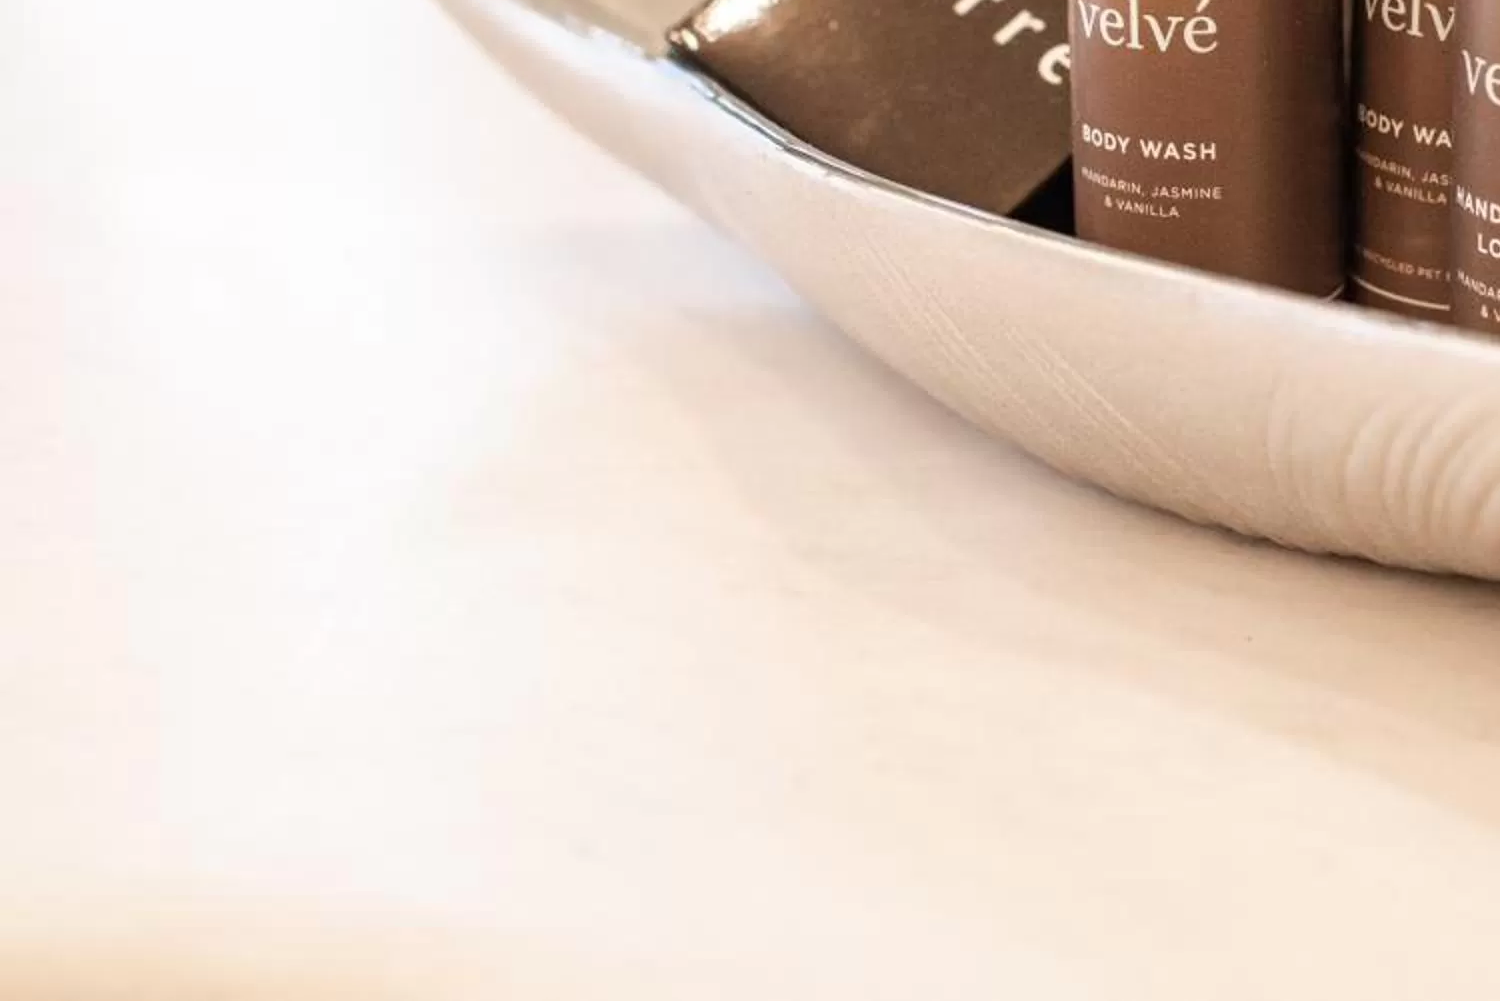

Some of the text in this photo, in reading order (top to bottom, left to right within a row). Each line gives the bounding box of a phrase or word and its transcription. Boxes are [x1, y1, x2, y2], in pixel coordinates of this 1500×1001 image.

[1081, 122, 1217, 161] BODY WASH
[1412, 124, 1453, 148] WA
[1081, 166, 1224, 200] MANDARIN, JASMINE
[1104, 194, 1180, 218] & VANILLA
[1480, 304, 1490, 319] &
